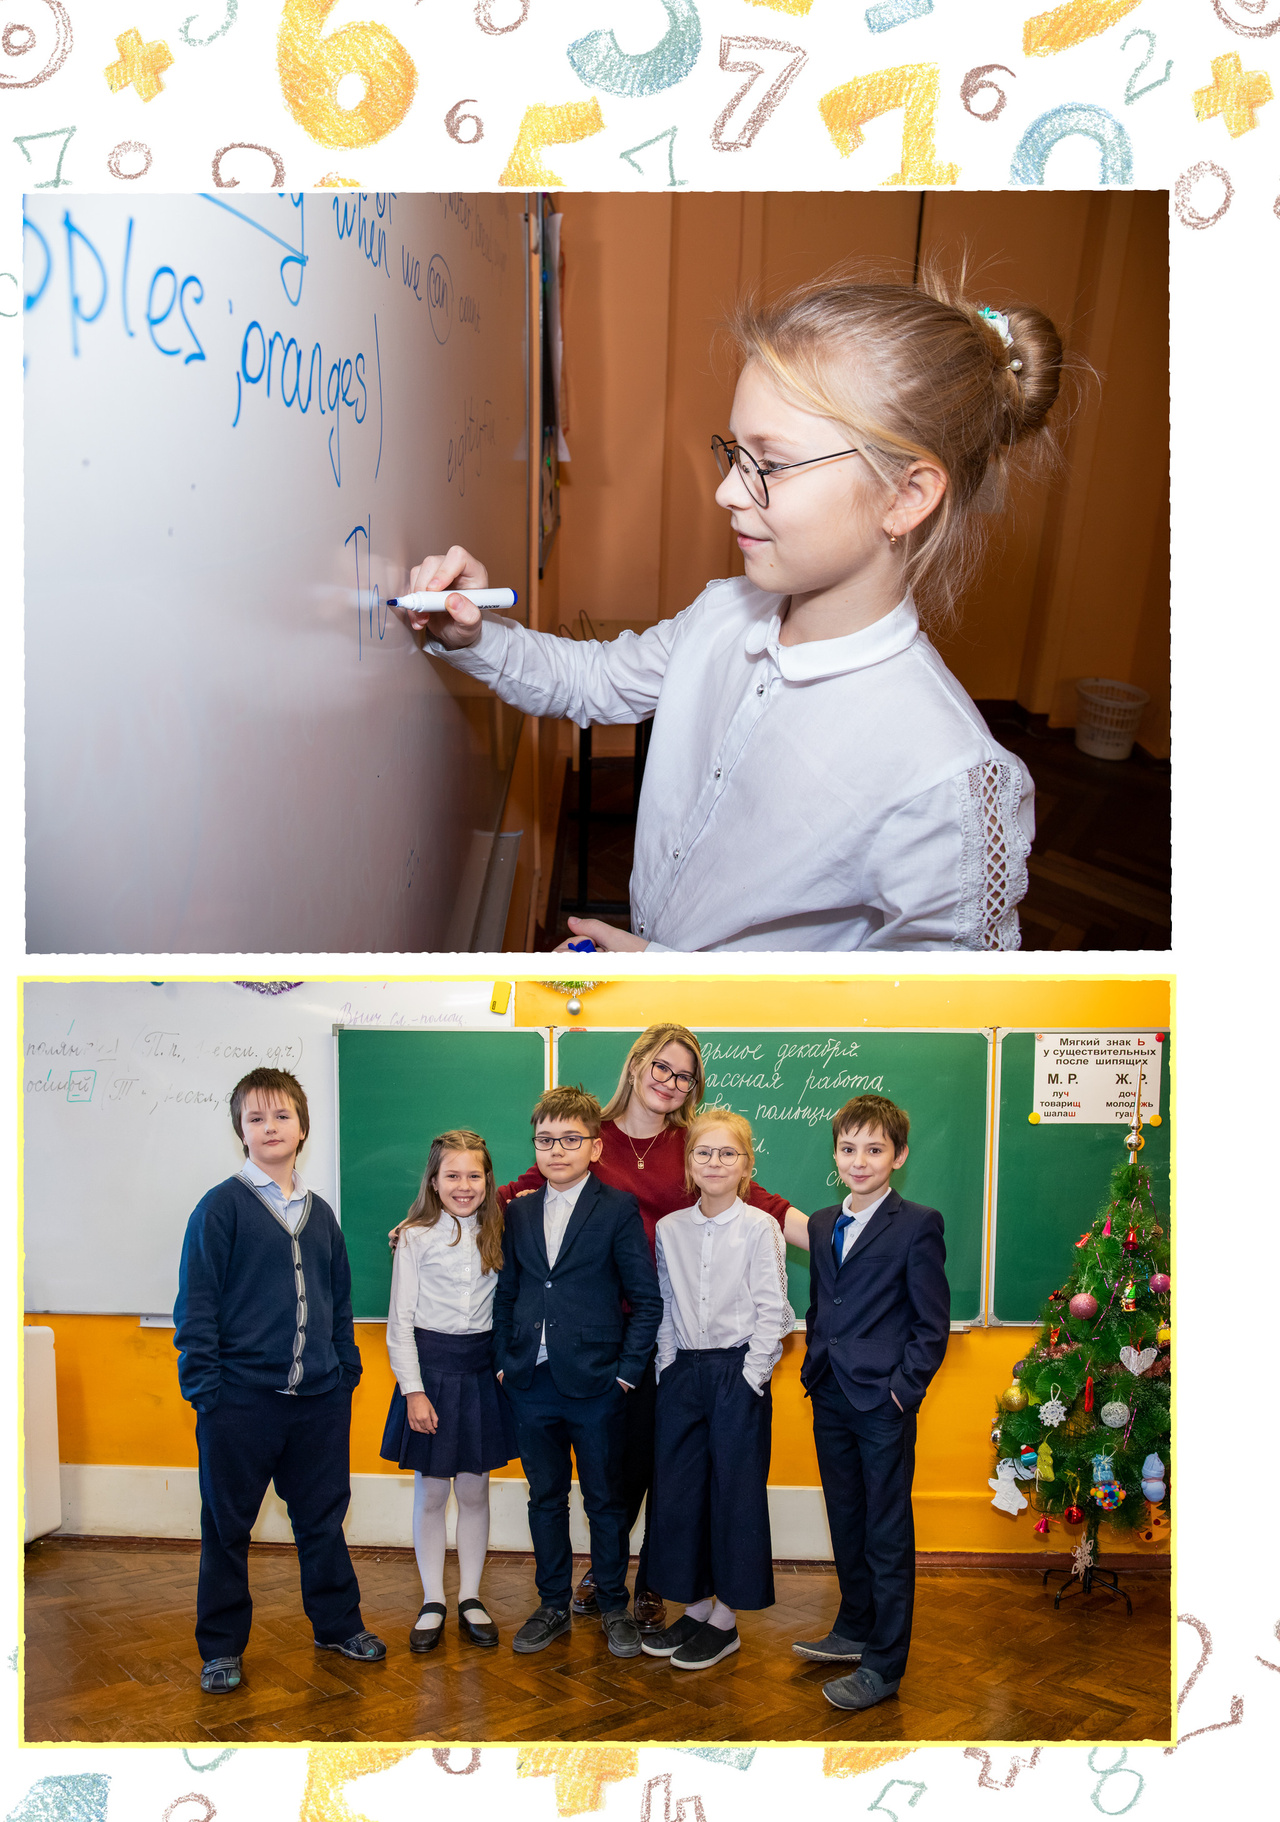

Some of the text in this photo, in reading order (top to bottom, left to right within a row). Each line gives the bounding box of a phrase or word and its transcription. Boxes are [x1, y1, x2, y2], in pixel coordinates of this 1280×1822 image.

[332, 193, 391, 279] when
[402, 245, 423, 301] we
[429, 266, 449, 317] can
[1059, 1037, 1100, 1047] Мягкий
[26, 1041, 83, 1057] полян
[1043, 1048, 1156, 1057] у существительных
[1055, 1058, 1148, 1066] после шипящих
[1047, 1073, 1079, 1085] М. Р.
[1115, 1073, 1132, 1085] Ж.
[704, 1069, 891, 1104] ассная работа.
[1118, 1090, 1142, 1098] доч
